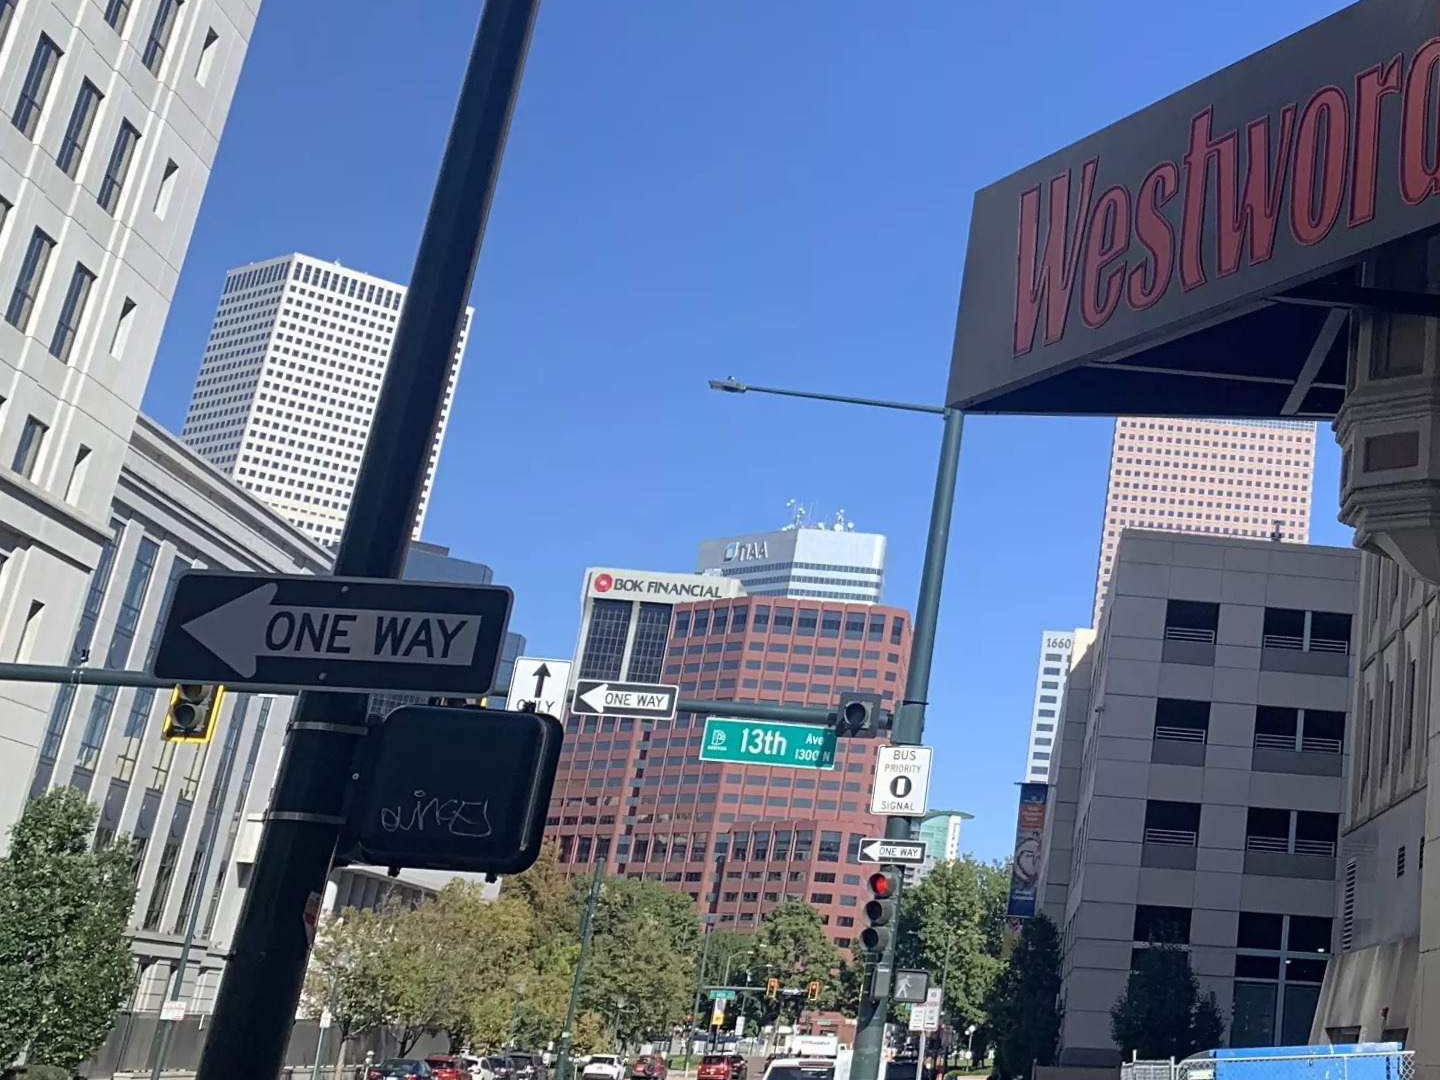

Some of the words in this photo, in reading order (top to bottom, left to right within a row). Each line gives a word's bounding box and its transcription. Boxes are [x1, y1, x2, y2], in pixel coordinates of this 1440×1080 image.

[738, 541, 768, 562] TIAA
[613, 578, 644, 593] BOK
[647, 581, 722, 599] FINANCIAL
[265, 611, 357, 654] ONE
[373, 616, 468, 659] WAY
[1046, 637, 1072, 649] 1660
[516, 698, 555, 714] OLY
[604, 692, 631, 706] ONE
[636, 694, 665, 708] WAY
[740, 728, 787, 756] 13th
[804, 732, 824, 745] Ave
[794, 748, 819, 761] 1300
[822, 751, 830, 762] N
[893, 750, 917, 761] BUS
[884, 763, 922, 774] PRIORITY
[881, 801, 915, 811] SIGNAL
[879, 847, 897, 856] ONE
[900, 848, 919, 857] WAY
